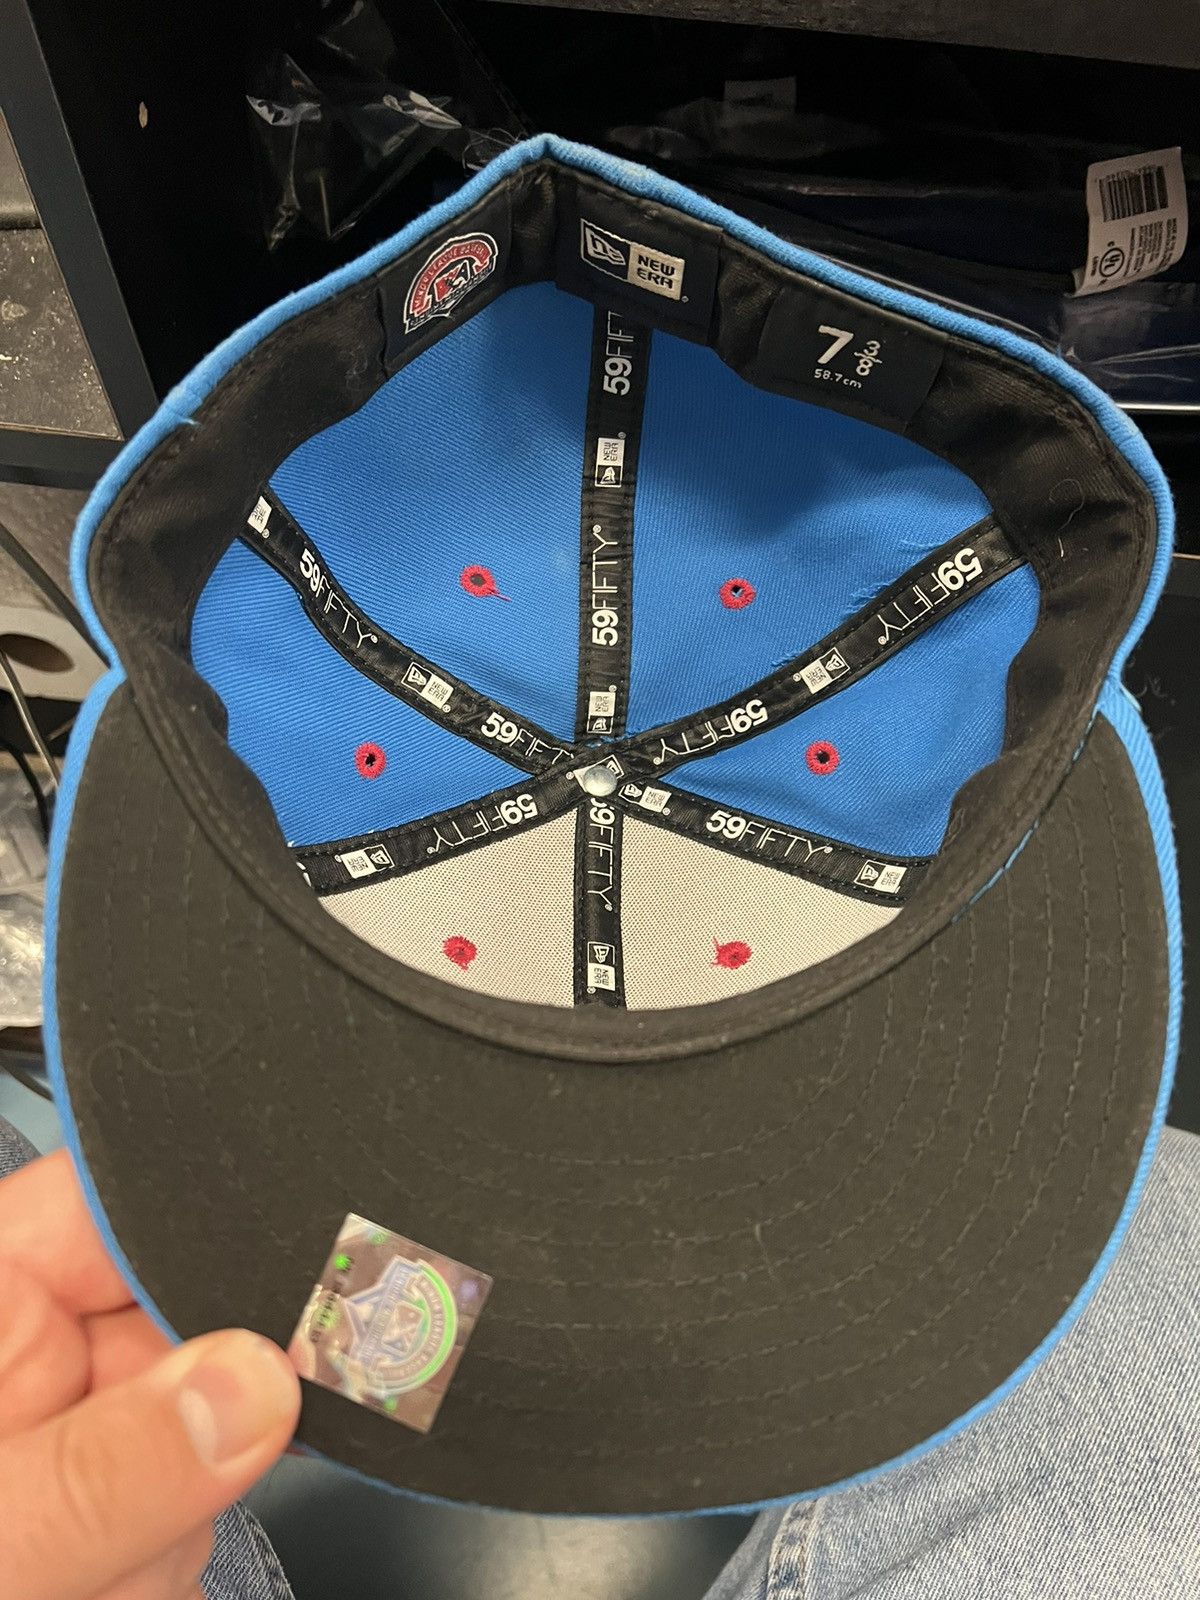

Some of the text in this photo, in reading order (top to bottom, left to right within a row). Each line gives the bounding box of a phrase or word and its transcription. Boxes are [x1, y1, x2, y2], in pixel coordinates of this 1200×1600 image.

[637, 268, 674, 290] ERA
[638, 254, 676, 277] NEW
[817, 325, 854, 364] 7
[300, 548, 372, 648] 59FIFTY
[592, 532, 619, 647] 59FIFTY
[877, 548, 984, 641] 59FIFTY
[481, 711, 575, 765] 59FIFT
[660, 699, 768, 762] 59FIFTY
[433, 793, 538, 852] 59FIFTY
[706, 810, 824, 862] 59FIFTY
